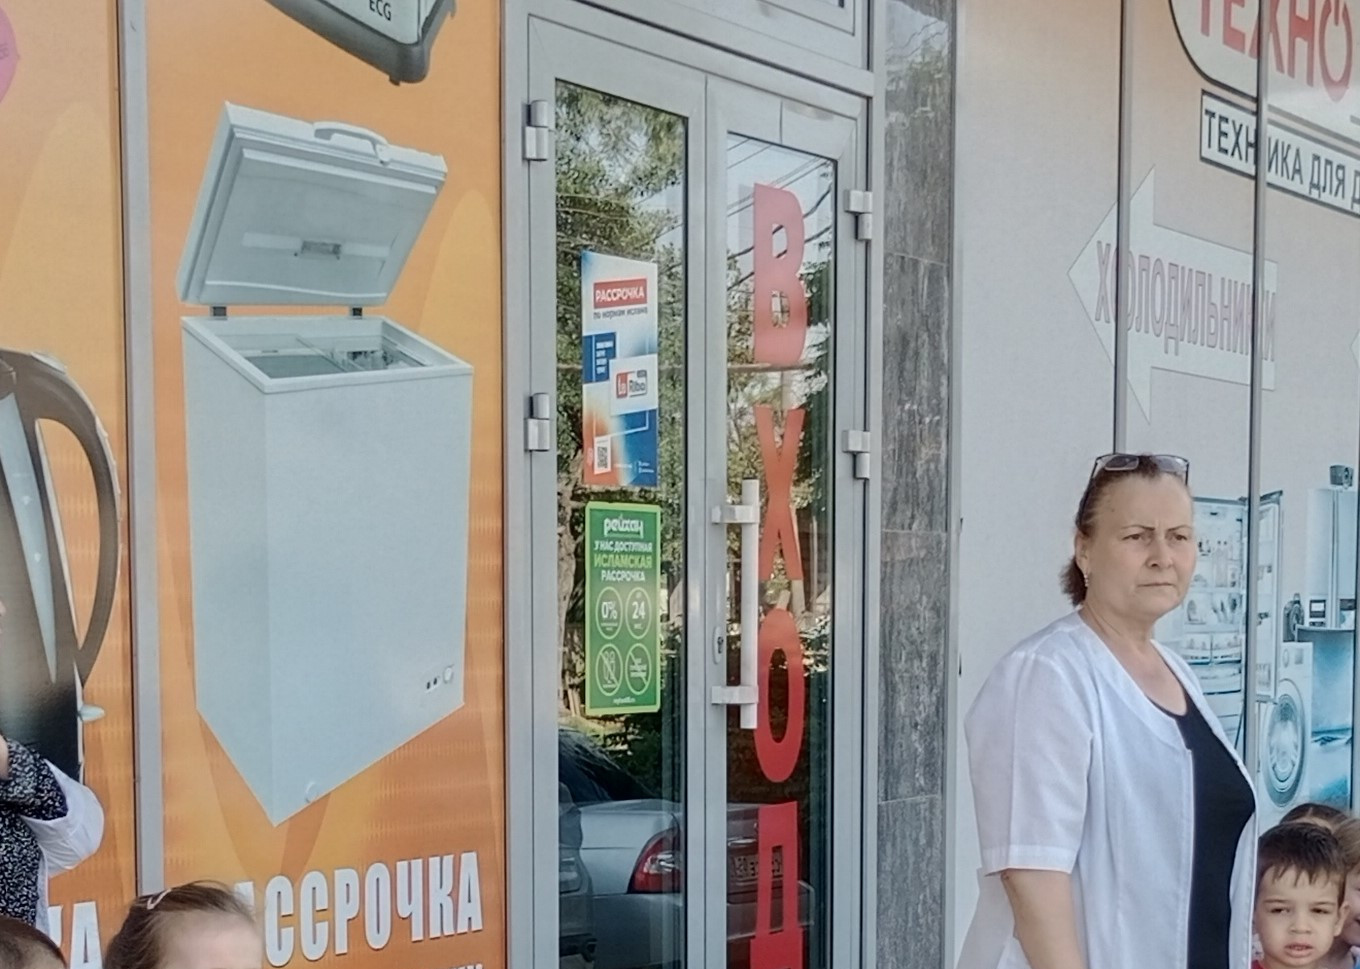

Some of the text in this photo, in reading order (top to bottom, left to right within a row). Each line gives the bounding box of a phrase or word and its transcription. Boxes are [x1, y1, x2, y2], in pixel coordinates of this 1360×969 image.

[368, 0, 392, 21] ECG
[1204, 108, 1304, 185] ТЕХНИКА
[1308, 153, 1345, 199] ДЛЯ
[595, 286, 645, 303] РАССРОЧКА
[594, 553, 653, 569] ИСЛАМСКАЯ
[601, 569, 646, 582] РАССРОЧКА
[601, 601, 618, 620] 0%
[632, 601, 646, 620] 24
[235, 851, 484, 968] ССРОЧКА
